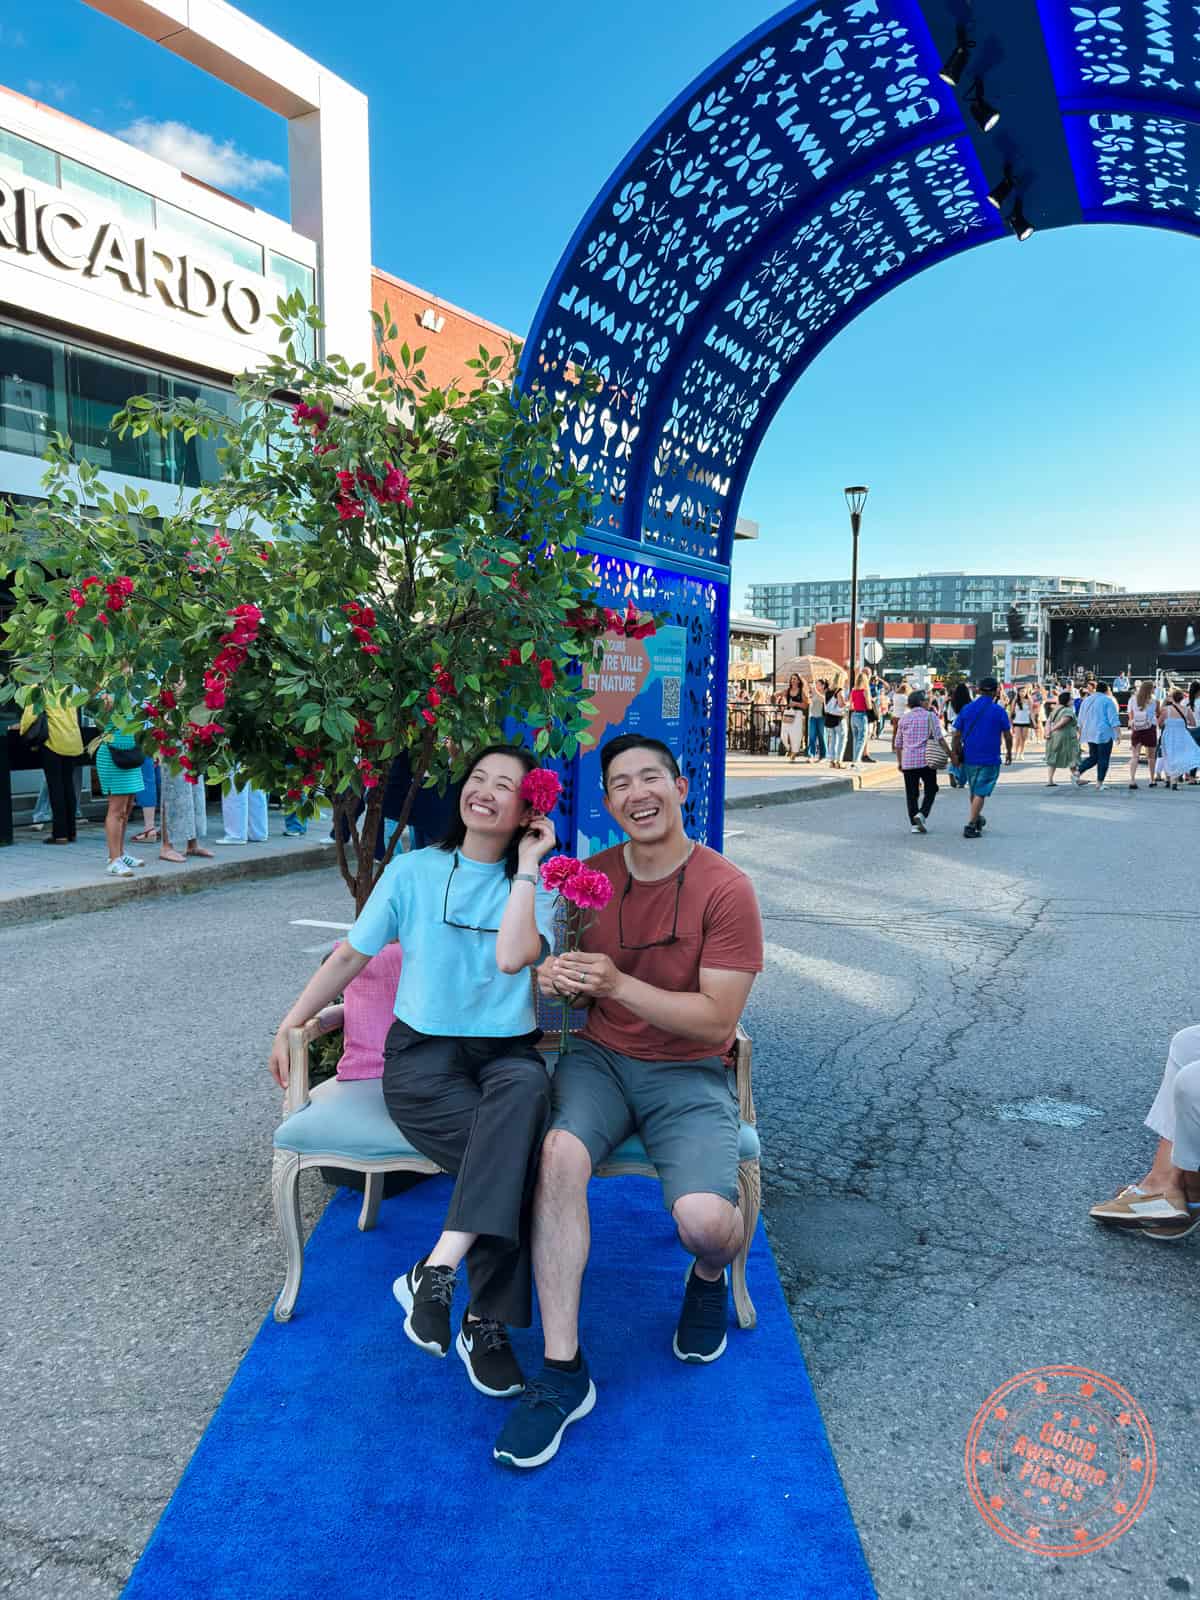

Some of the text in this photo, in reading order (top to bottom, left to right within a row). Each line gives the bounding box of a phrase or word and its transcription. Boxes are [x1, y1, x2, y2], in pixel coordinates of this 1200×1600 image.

[0, 176, 268, 335] RICARDO
[621, 655, 643, 672] VILLE
[588, 673, 636, 693] ET NATURE
